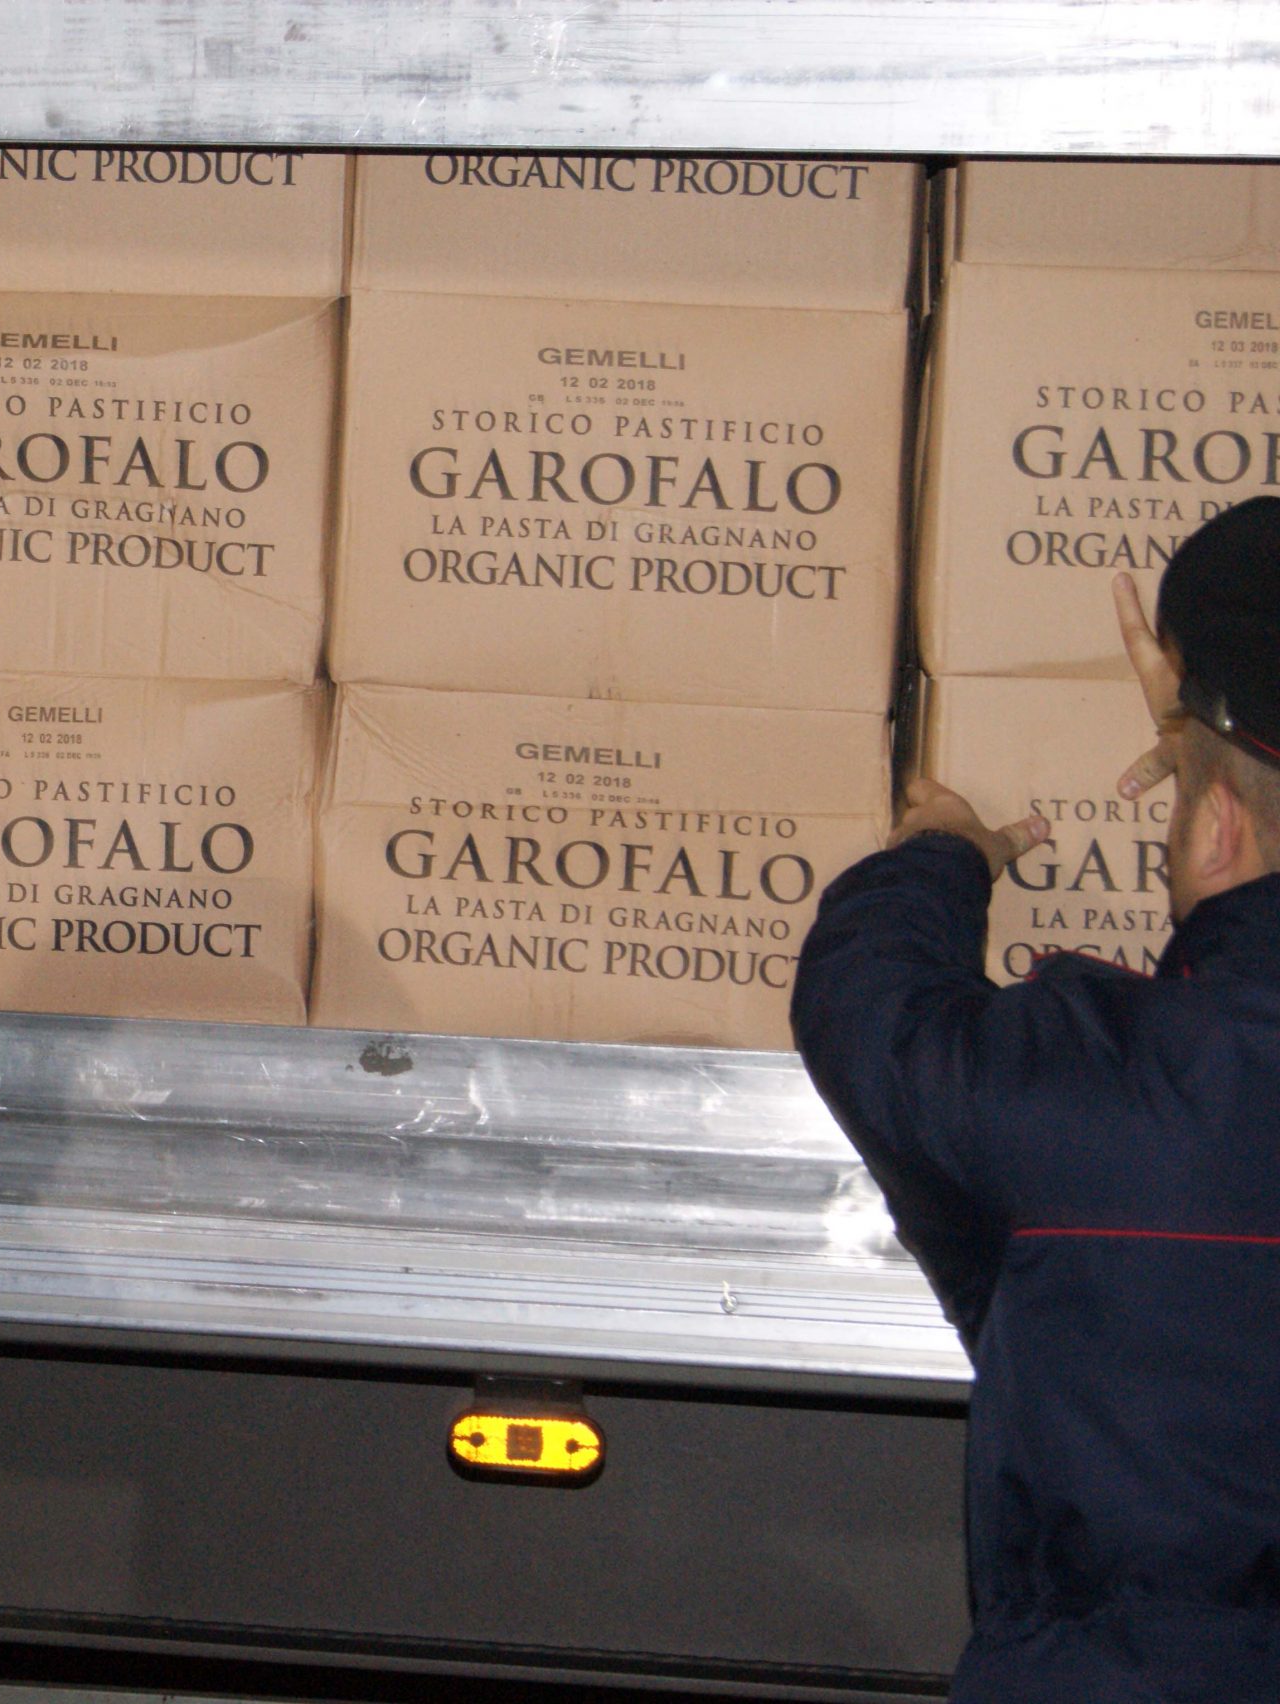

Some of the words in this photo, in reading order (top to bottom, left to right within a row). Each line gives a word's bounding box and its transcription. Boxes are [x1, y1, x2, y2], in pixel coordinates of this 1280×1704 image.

[92, 150, 304, 186] PRODUCT
[424, 155, 635, 192] ORGANIC
[650, 159, 869, 200] PRODUCT
[537, 347, 685, 370] GEMELLI
[1211, 340, 1225, 352] 12
[1231, 340, 1245, 352] 03
[23, 358, 42, 370] 02
[50, 359, 89, 371] 2018
[560, 376, 579, 388] 12
[588, 377, 609, 389] 02
[616, 379, 656, 391] 2018
[1036, 385, 1207, 413] STORICO
[48, 396, 253, 426] PASTIFICIO
[431, 409, 593, 436] STORICO
[614, 415, 825, 446] PASTIFICIO
[409, 446, 842, 516] GAROFALO
[24, 496, 57, 518] DI
[70, 498, 247, 530] GRAGNANO
[1036, 495, 1073, 518] LA
[1088, 497, 1184, 522] PASTA
[430, 514, 467, 536] LA
[480, 516, 572, 541] PASTA
[586, 520, 619, 543] DI
[634, 523, 818, 552] GRAGNANO
[65, 531, 275, 577] PRODUCT
[1006, 530, 1189, 570] ORGAN
[403, 548, 616, 591] ORGANIC
[630, 557, 847, 601] PRODUCT
[7, 705, 103, 723] GEMELLI
[21, 733, 34, 743] 12
[39, 733, 52, 744] 02
[57, 734, 83, 744] 2018
[515, 742, 662, 769] GEMELLI
[34, 780, 237, 807] PASTIFICIO
[537, 772, 556, 783] 12
[565, 773, 585, 785] 02
[593, 775, 632, 788] 2018
[410, 796, 569, 826] STORICO
[590, 808, 798, 839] PASTIFICIO
[385, 829, 815, 906] GAROFALO
[7, 882, 39, 904] DI
[54, 884, 233, 910] GRAGNANO
[406, 894, 441, 916] LA
[455, 897, 547, 923] PASTA
[560, 903, 592, 926] DI
[608, 907, 791, 941] GRAGNANO
[1031, 907, 1068, 929] LA
[51, 918, 262, 958] PRODUCT
[378, 927, 589, 973] ORGANIC
[602, 940, 802, 989] PRODUC
